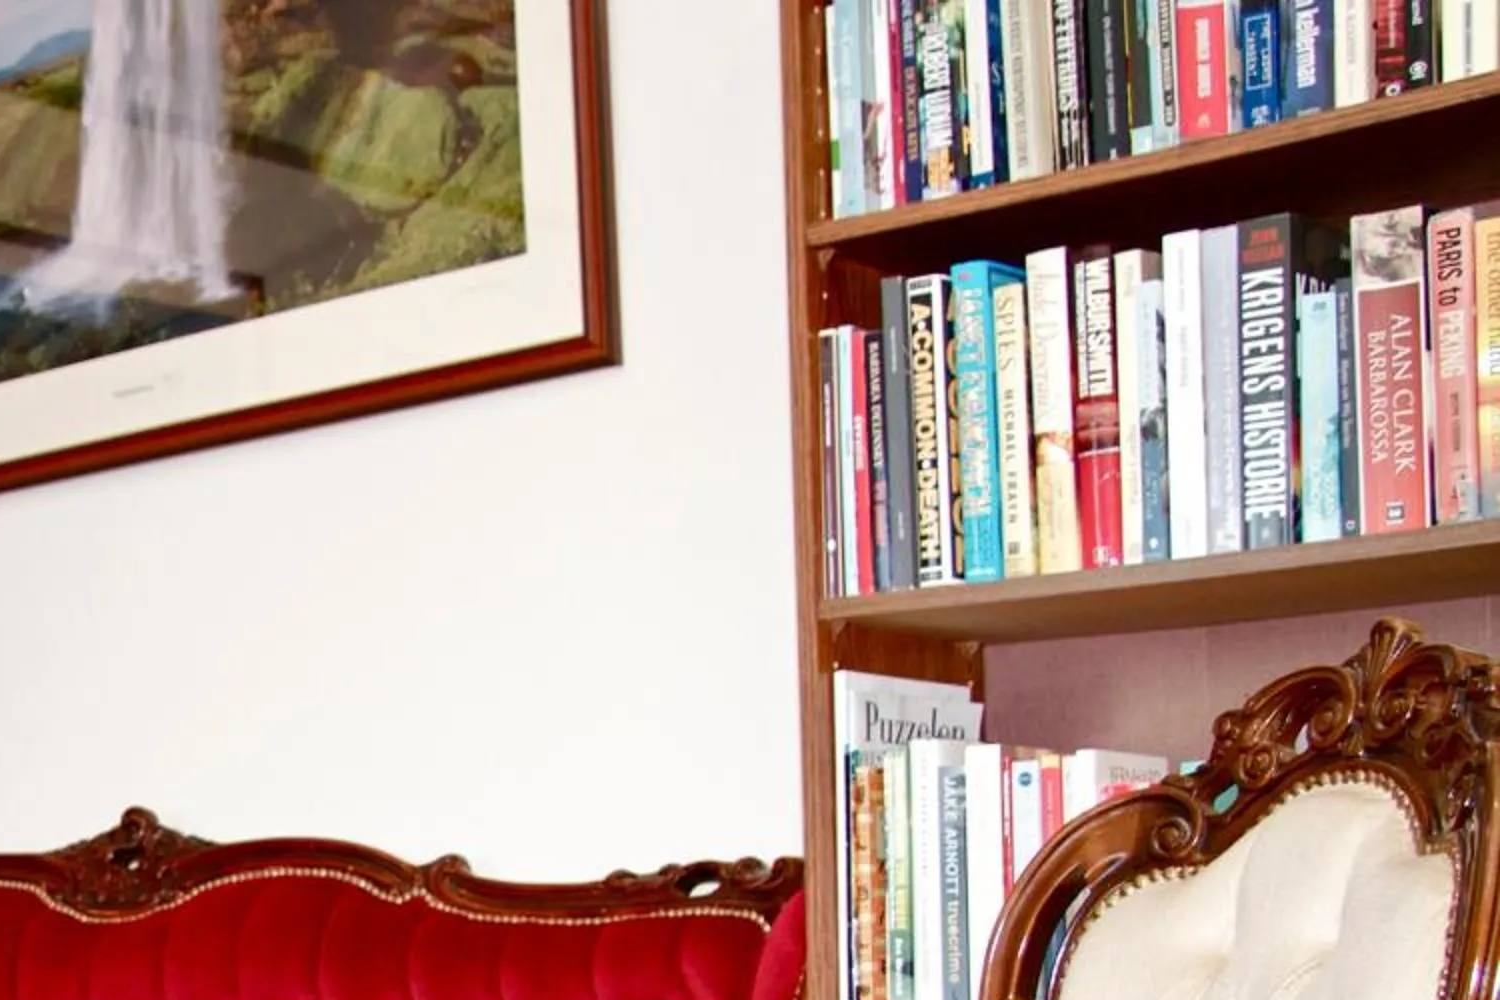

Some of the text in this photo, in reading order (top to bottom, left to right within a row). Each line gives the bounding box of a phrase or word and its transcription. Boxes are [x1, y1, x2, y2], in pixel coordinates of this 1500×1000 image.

[923, 31, 953, 150] ROBERT LUDLUM
[1437, 226, 1463, 282] PARIS
[1438, 286, 1462, 306] to
[867, 341, 883, 402] BARBARA
[960, 287, 985, 364] JANET
[1085, 257, 1113, 396] WILBUR SMITH
[1439, 310, 1466, 380] PEKING
[870, 405, 885, 470] DELINSKY
[996, 296, 1020, 525] SPIES MICHAEL FRAYN
[1241, 266, 1287, 522] KRIGENS HISTORIE
[1366, 330, 1389, 465] BARBAROSSA
[1390, 313, 1417, 476] ALAN CLARK
[943, 775, 963, 985] JAKE ARNOTT truecrime
